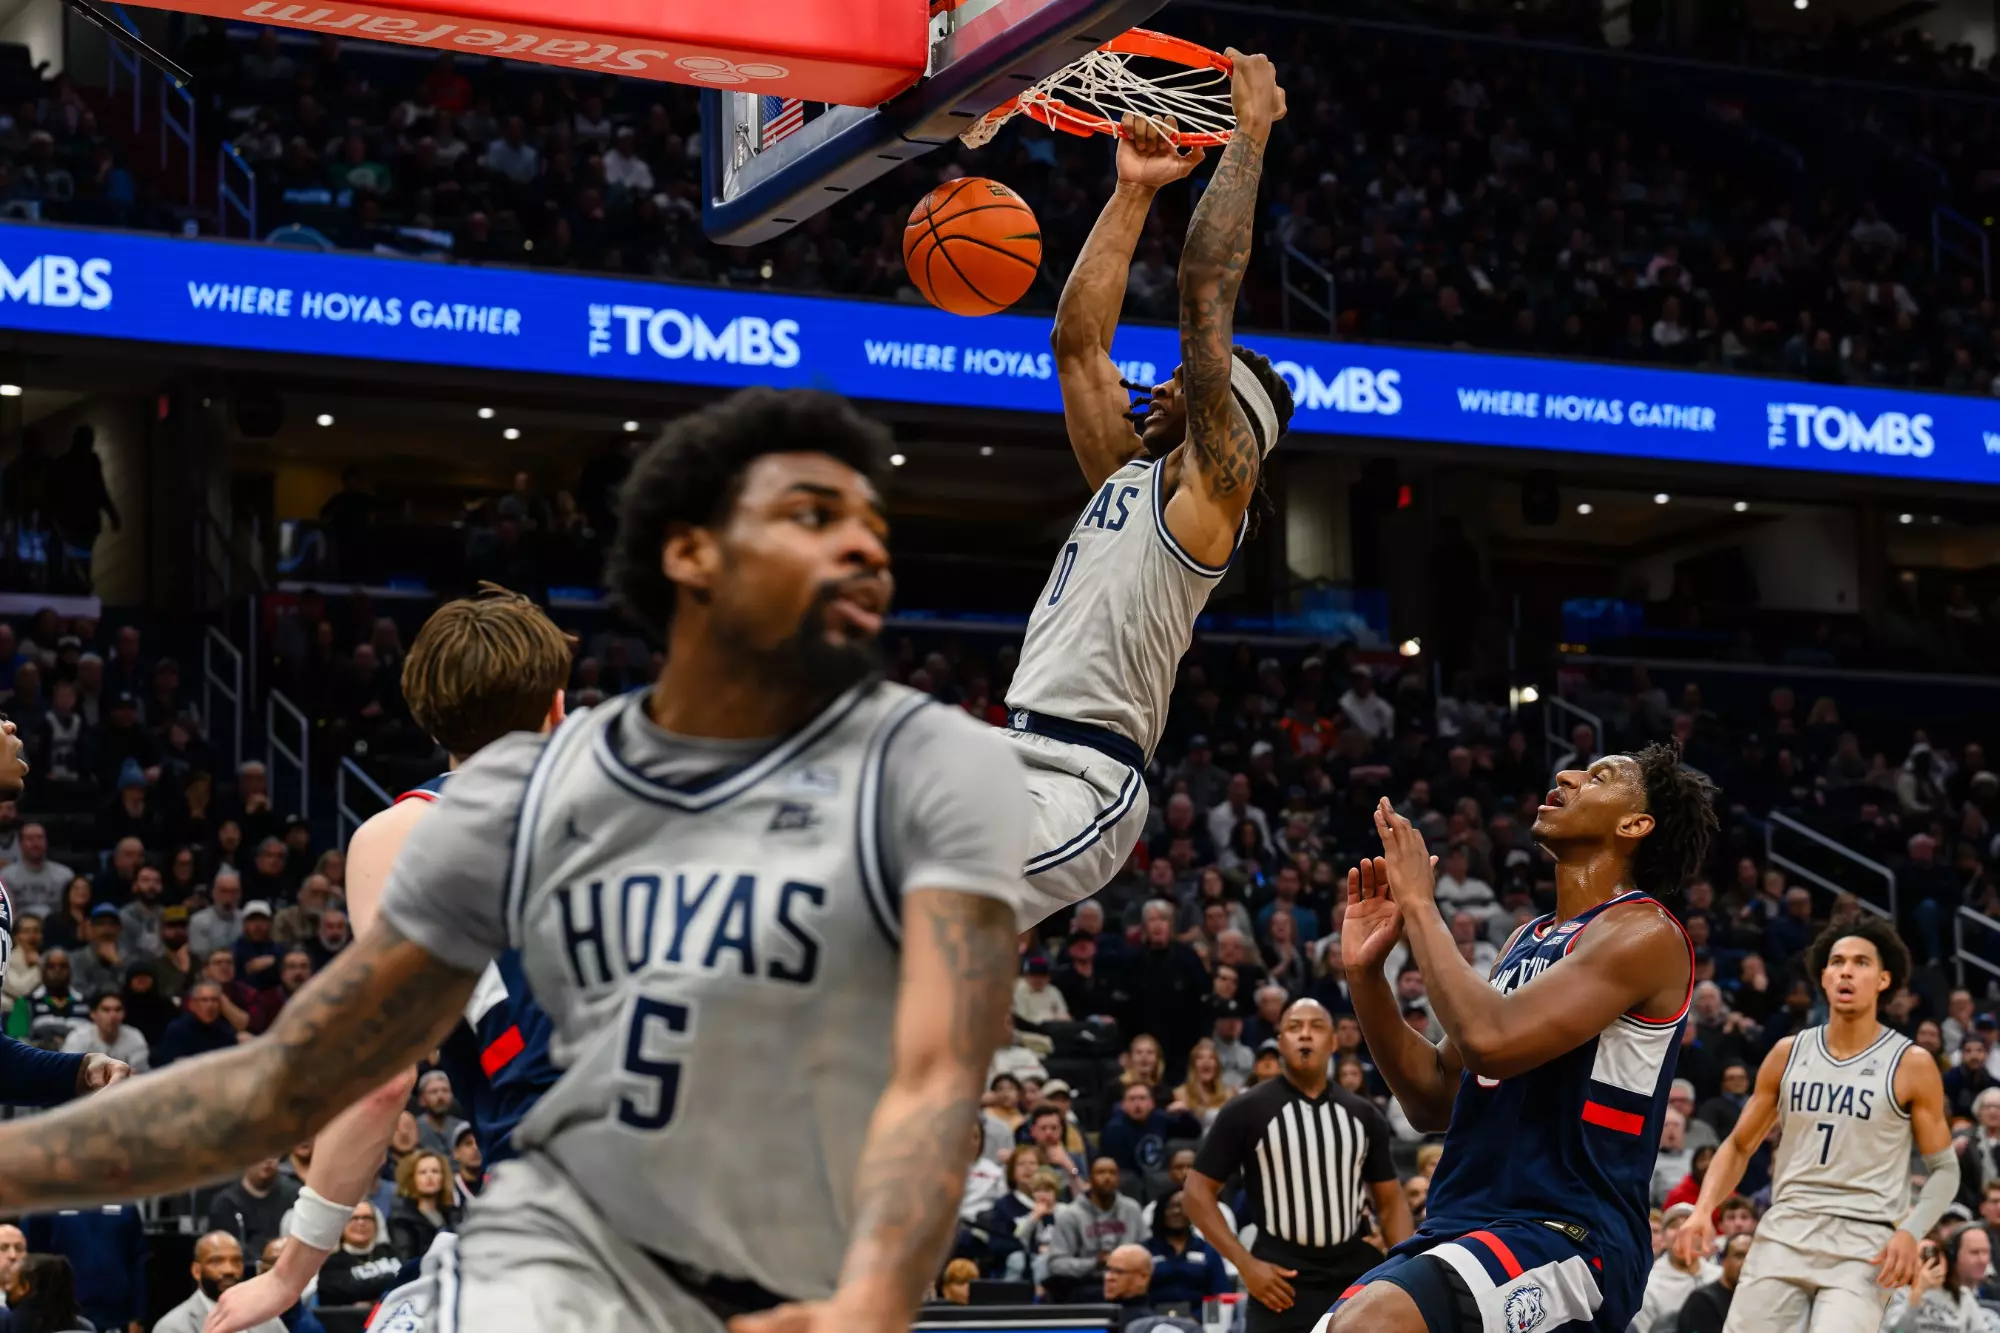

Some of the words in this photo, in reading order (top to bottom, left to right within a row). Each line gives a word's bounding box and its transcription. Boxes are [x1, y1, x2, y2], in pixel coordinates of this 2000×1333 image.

[0, 255, 112, 310] MBS
[188, 280, 293, 317] WHERE
[301, 291, 402, 326] HOYAS
[410, 300, 522, 336] GATHER
[612, 304, 800, 368] TOMBS
[864, 339, 956, 372] WHERE
[964, 348, 1051, 379] HOYAS
[1272, 360, 1402, 415] OMBS
[1457, 387, 1540, 418] WHERE
[1545, 395, 1624, 425] HOYAS
[1628, 401, 1717, 432] GATHER
[1787, 402, 1935, 458] TOMBS
[558, 873, 826, 987] HOYAS
[618, 995, 689, 1131] 5
[1790, 1082, 1874, 1120] HOYAS
[1817, 1123, 1835, 1165] 7
